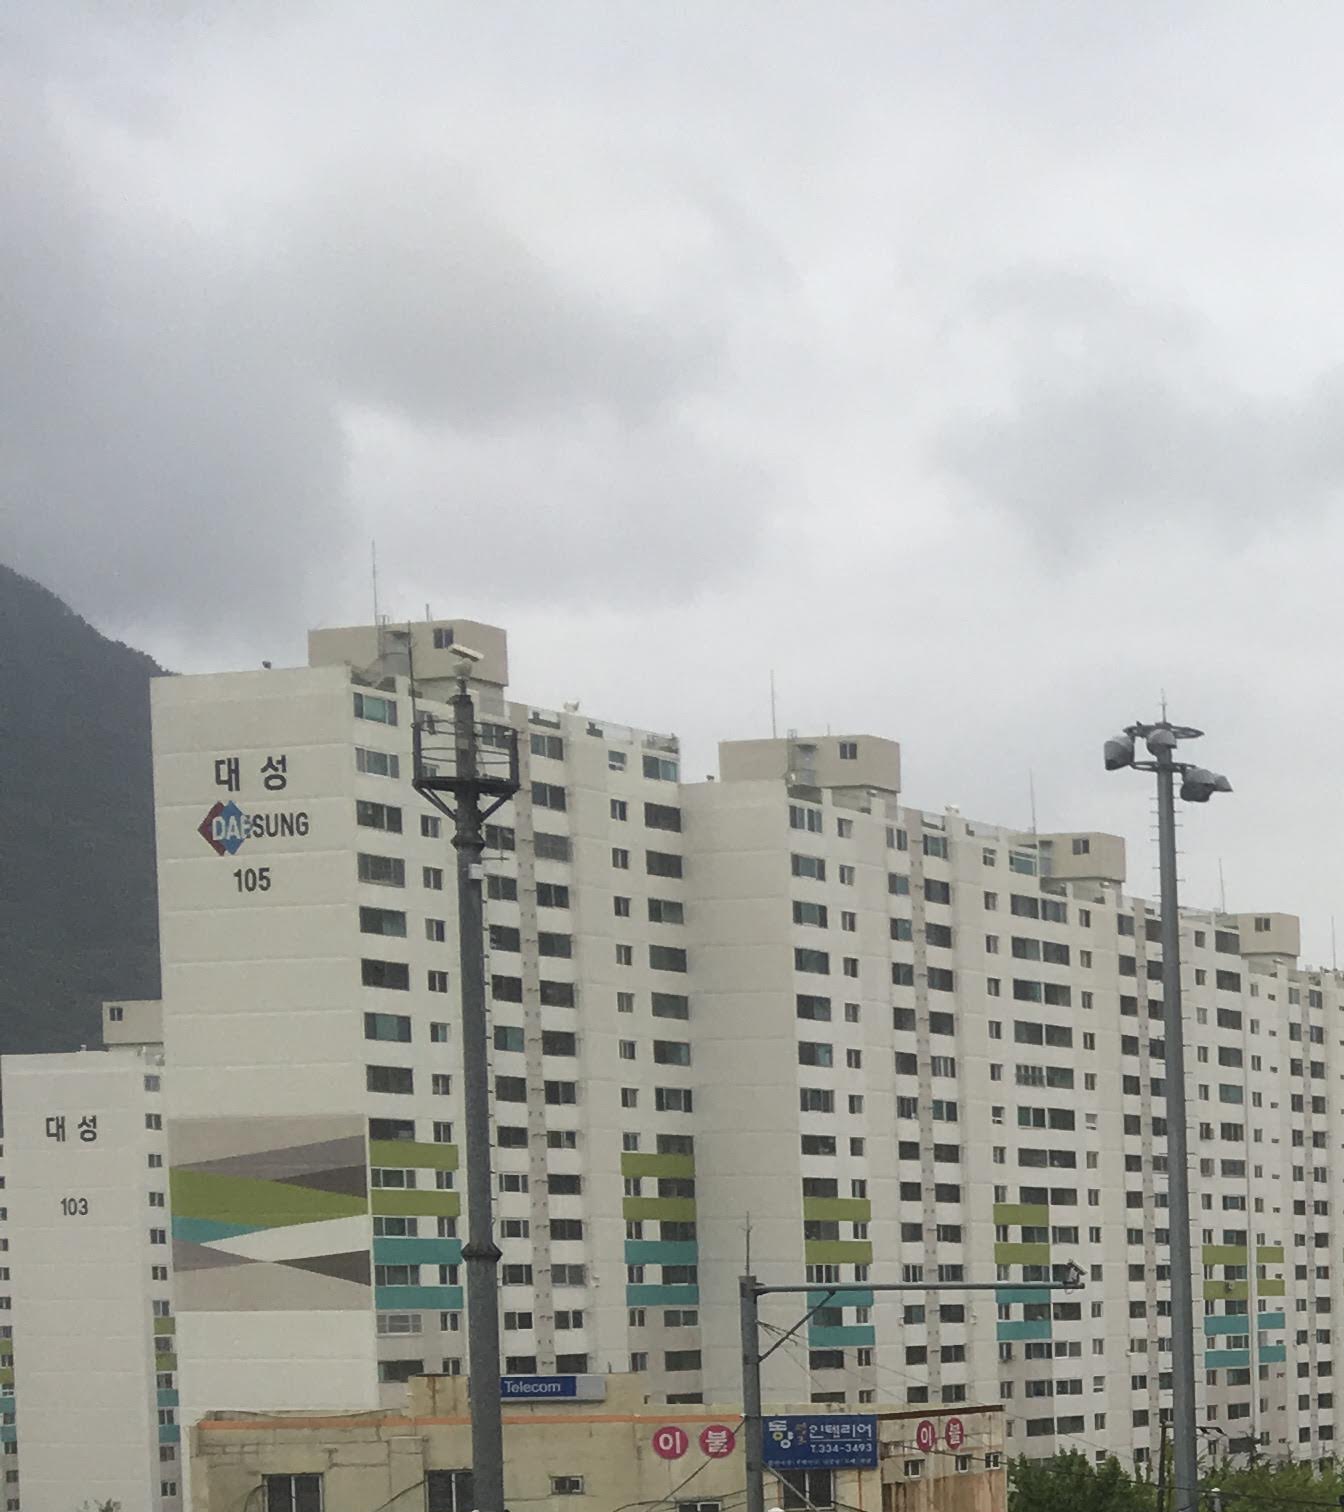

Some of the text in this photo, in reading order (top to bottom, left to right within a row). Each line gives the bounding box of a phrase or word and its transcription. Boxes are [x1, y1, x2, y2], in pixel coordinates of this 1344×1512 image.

[214, 755, 289, 793] 대성
[211, 810, 310, 842] DAESUNG
[232, 867, 272, 894] 105
[45, 1114, 99, 1142] 대성
[60, 1197, 89, 1217] 103
[504, 1380, 562, 1394] Telecom
